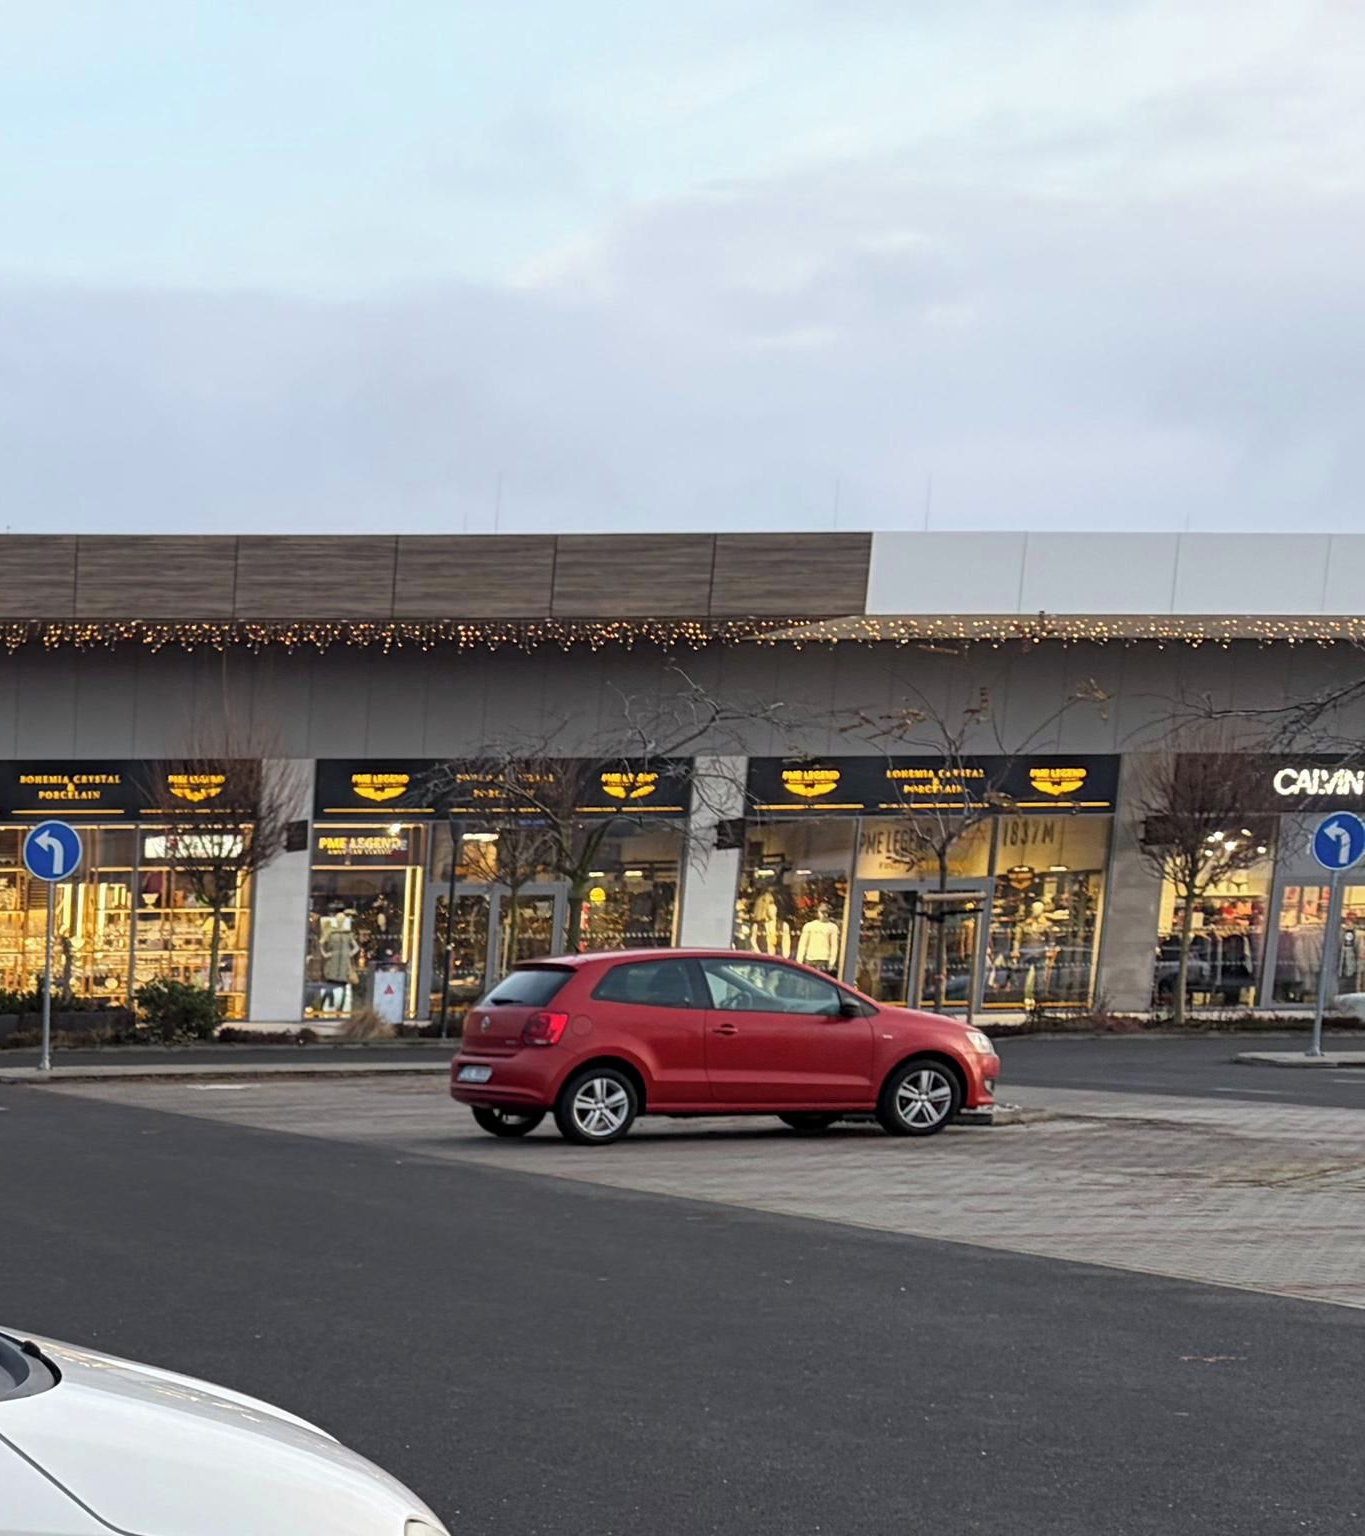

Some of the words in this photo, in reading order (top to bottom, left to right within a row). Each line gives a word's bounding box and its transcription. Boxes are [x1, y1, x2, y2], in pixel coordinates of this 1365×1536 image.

[20, 775, 69, 784] BOHEMIA
[73, 774, 121, 784] CRYSTAL
[1273, 768, 1365, 795] CALVIN
[38, 790, 101, 800] PORCELAIN
